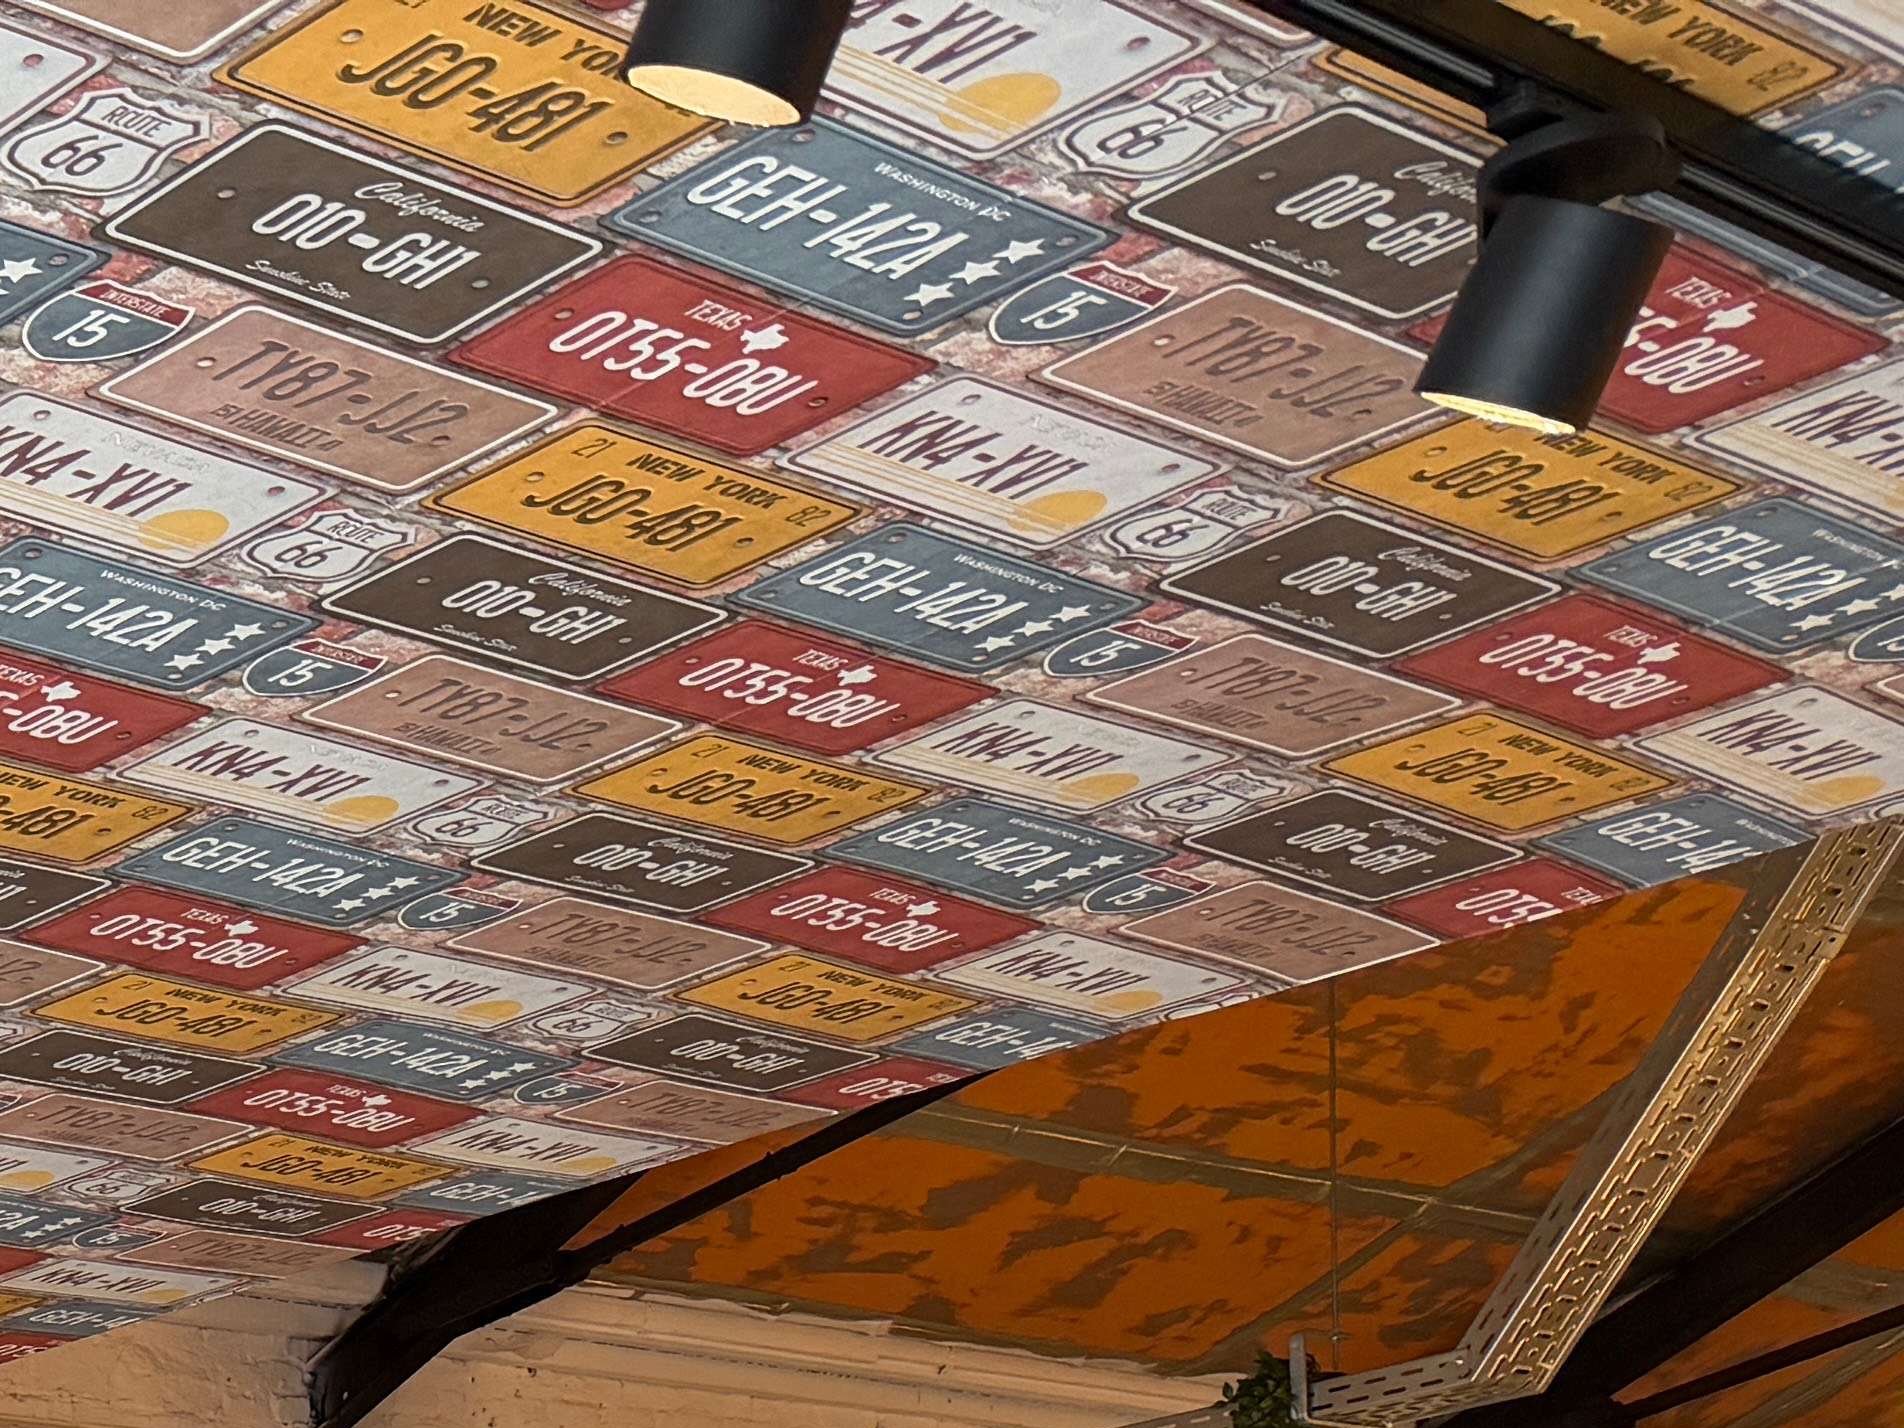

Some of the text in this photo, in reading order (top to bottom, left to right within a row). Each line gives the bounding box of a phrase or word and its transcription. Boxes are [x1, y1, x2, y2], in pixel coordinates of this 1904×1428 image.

[102, 105, 176, 131] ROUTE
[52, 137, 121, 175] 66
[354, 185, 482, 229] California
[687, 156, 961, 276] GEH-142A
[52, 310, 128, 346] 15
[1649, 526, 1862, 606] GEH-142A
[801, 551, 1025, 631] GEH-142A
